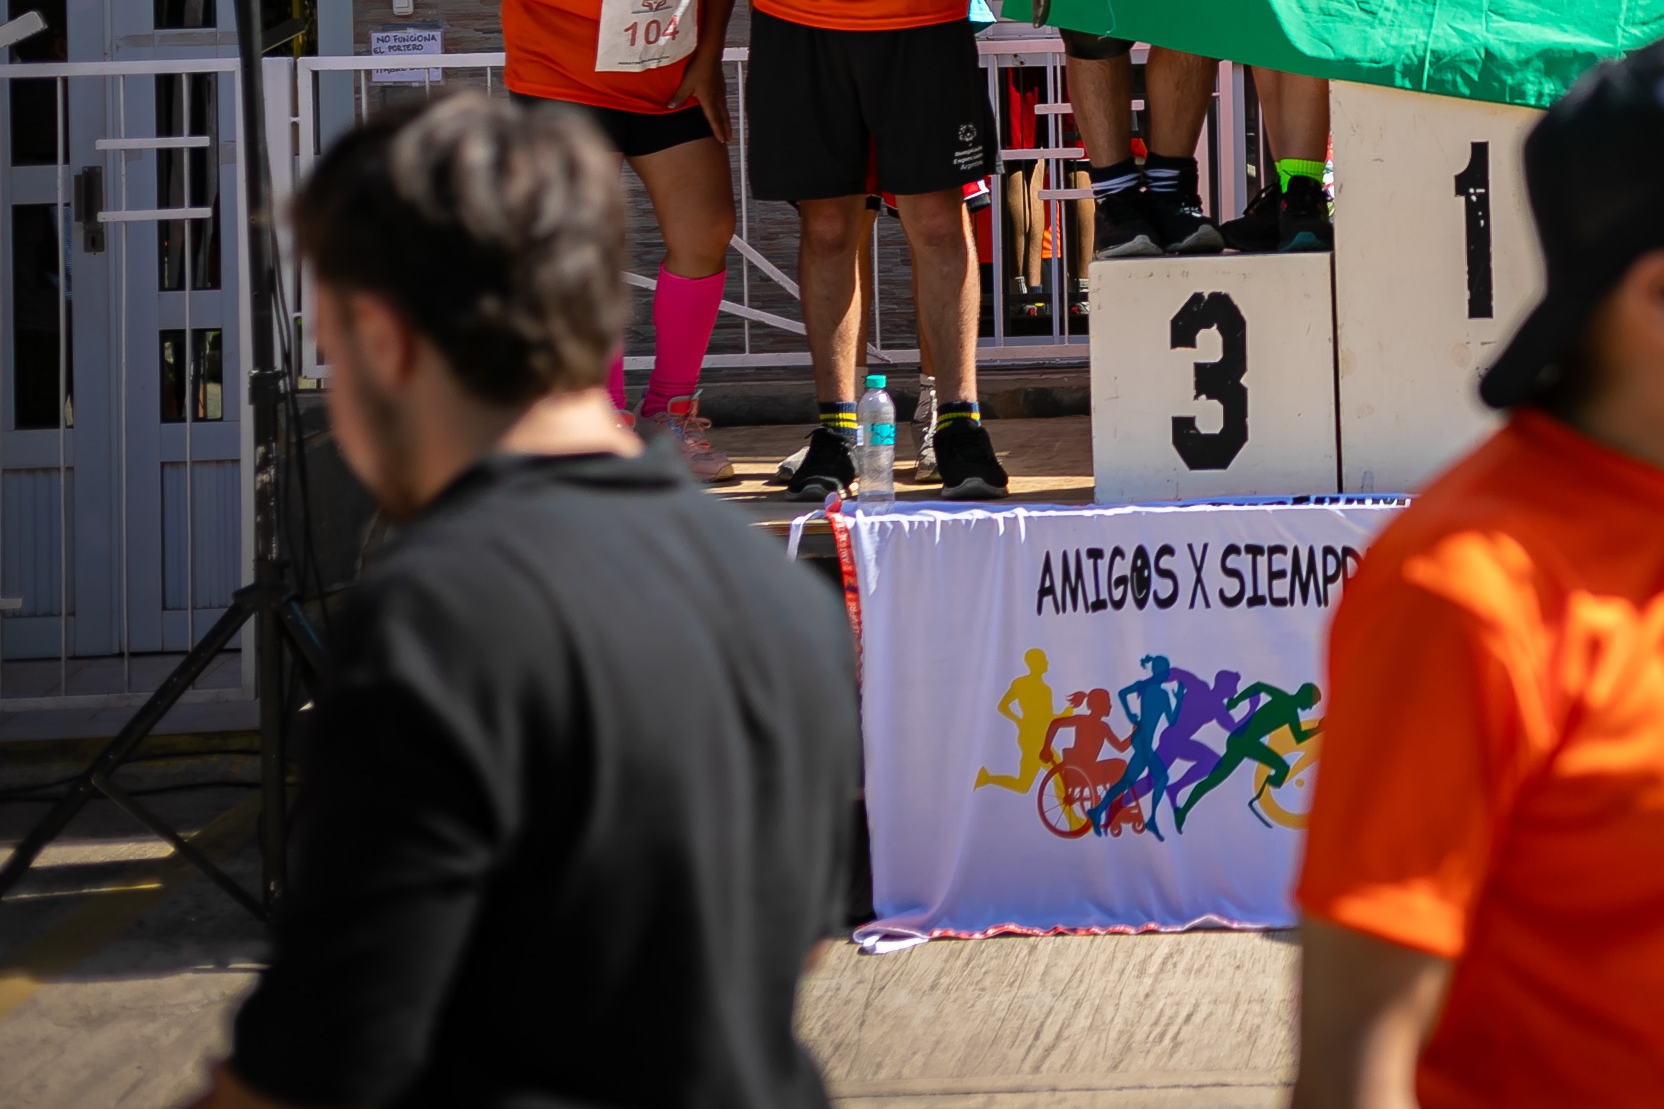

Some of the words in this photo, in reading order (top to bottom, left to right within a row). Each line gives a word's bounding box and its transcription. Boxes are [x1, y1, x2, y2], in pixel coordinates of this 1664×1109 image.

[373, 46, 385, 55] EL
[387, 43, 424, 53] PORTERO
[376, 35, 391, 44] NO
[623, 15, 680, 47] 104
[1454, 141, 1494, 320] 1
[1170, 291, 1249, 472] 3
[1037, 543, 1181, 617] AMIGOS
[1187, 542, 1212, 611] X
[1218, 542, 1372, 611] SIEMP
